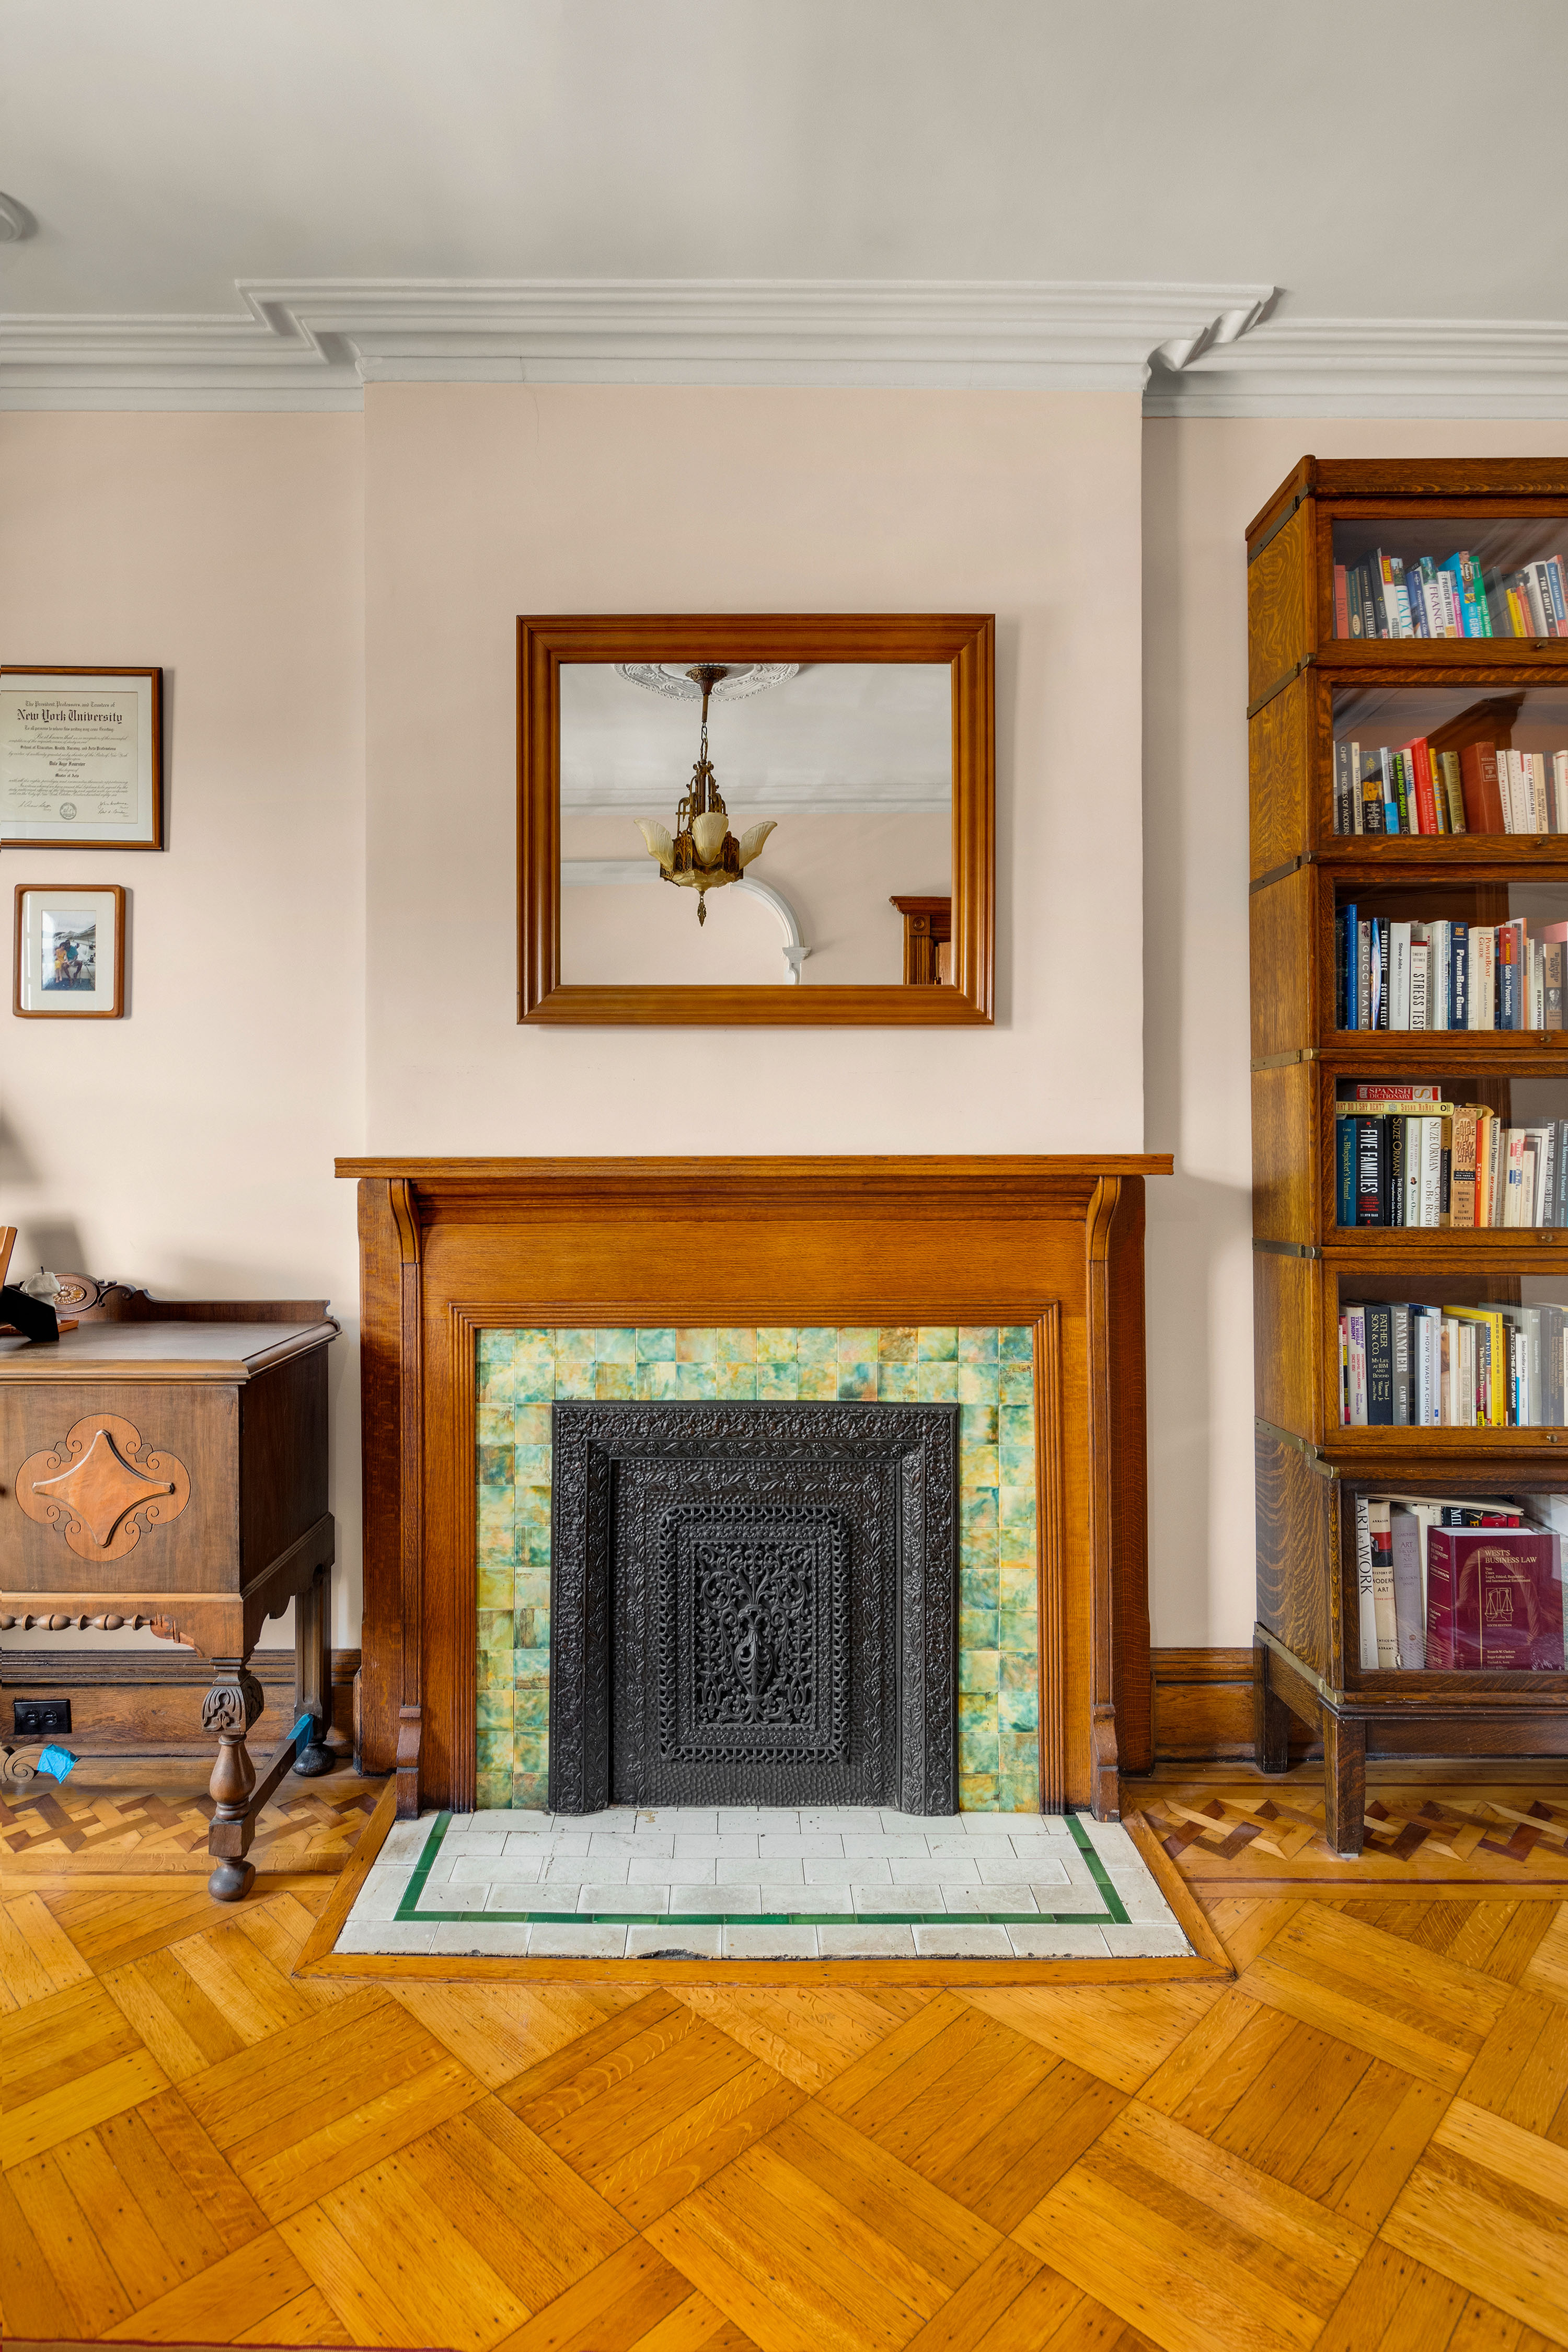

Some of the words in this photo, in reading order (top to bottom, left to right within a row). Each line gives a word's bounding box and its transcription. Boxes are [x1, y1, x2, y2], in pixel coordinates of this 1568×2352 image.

[1397, 590, 1413, 630] ITALY
[1430, 586, 1444, 631] FRANCE
[1543, 593, 1552, 614] GRIFT
[1367, 618, 1375, 638] TUSCAN
[1469, 618, 1479, 637] GERM
[17, 709, 39, 720] New
[42, 709, 66, 722] York
[68, 709, 122, 723] University
[1448, 761, 1458, 786] DELIRIUM
[1343, 800, 1348, 808] OF
[1426, 788, 1435, 820] TREASURE
[1452, 794, 1460, 805] THE
[1454, 805, 1463, 823] BRAVE
[1413, 973, 1424, 1006] STRESS
[1413, 1010, 1424, 1030] TEST
[1360, 1129, 1378, 1149] FIVE
[1342, 1142, 1351, 1177] Bluejacket's
[1392, 1141, 1402, 1176] ORMAN
[1429, 1143, 1440, 1171] ORMAN
[1360, 1152, 1378, 1193] FAMILIES
[1490, 1175, 1494, 1185] MY
[1426, 1180, 1432, 1189] to
[1396, 1312, 1408, 1373] FINANCIER
[1425, 1355, 1429, 1363] TO
[1511, 1381, 1515, 1391] OF
[1357, 1504, 1369, 1534] ART
[1358, 1535, 1364, 1544] AT
[1358, 1544, 1373, 1595] WORK
